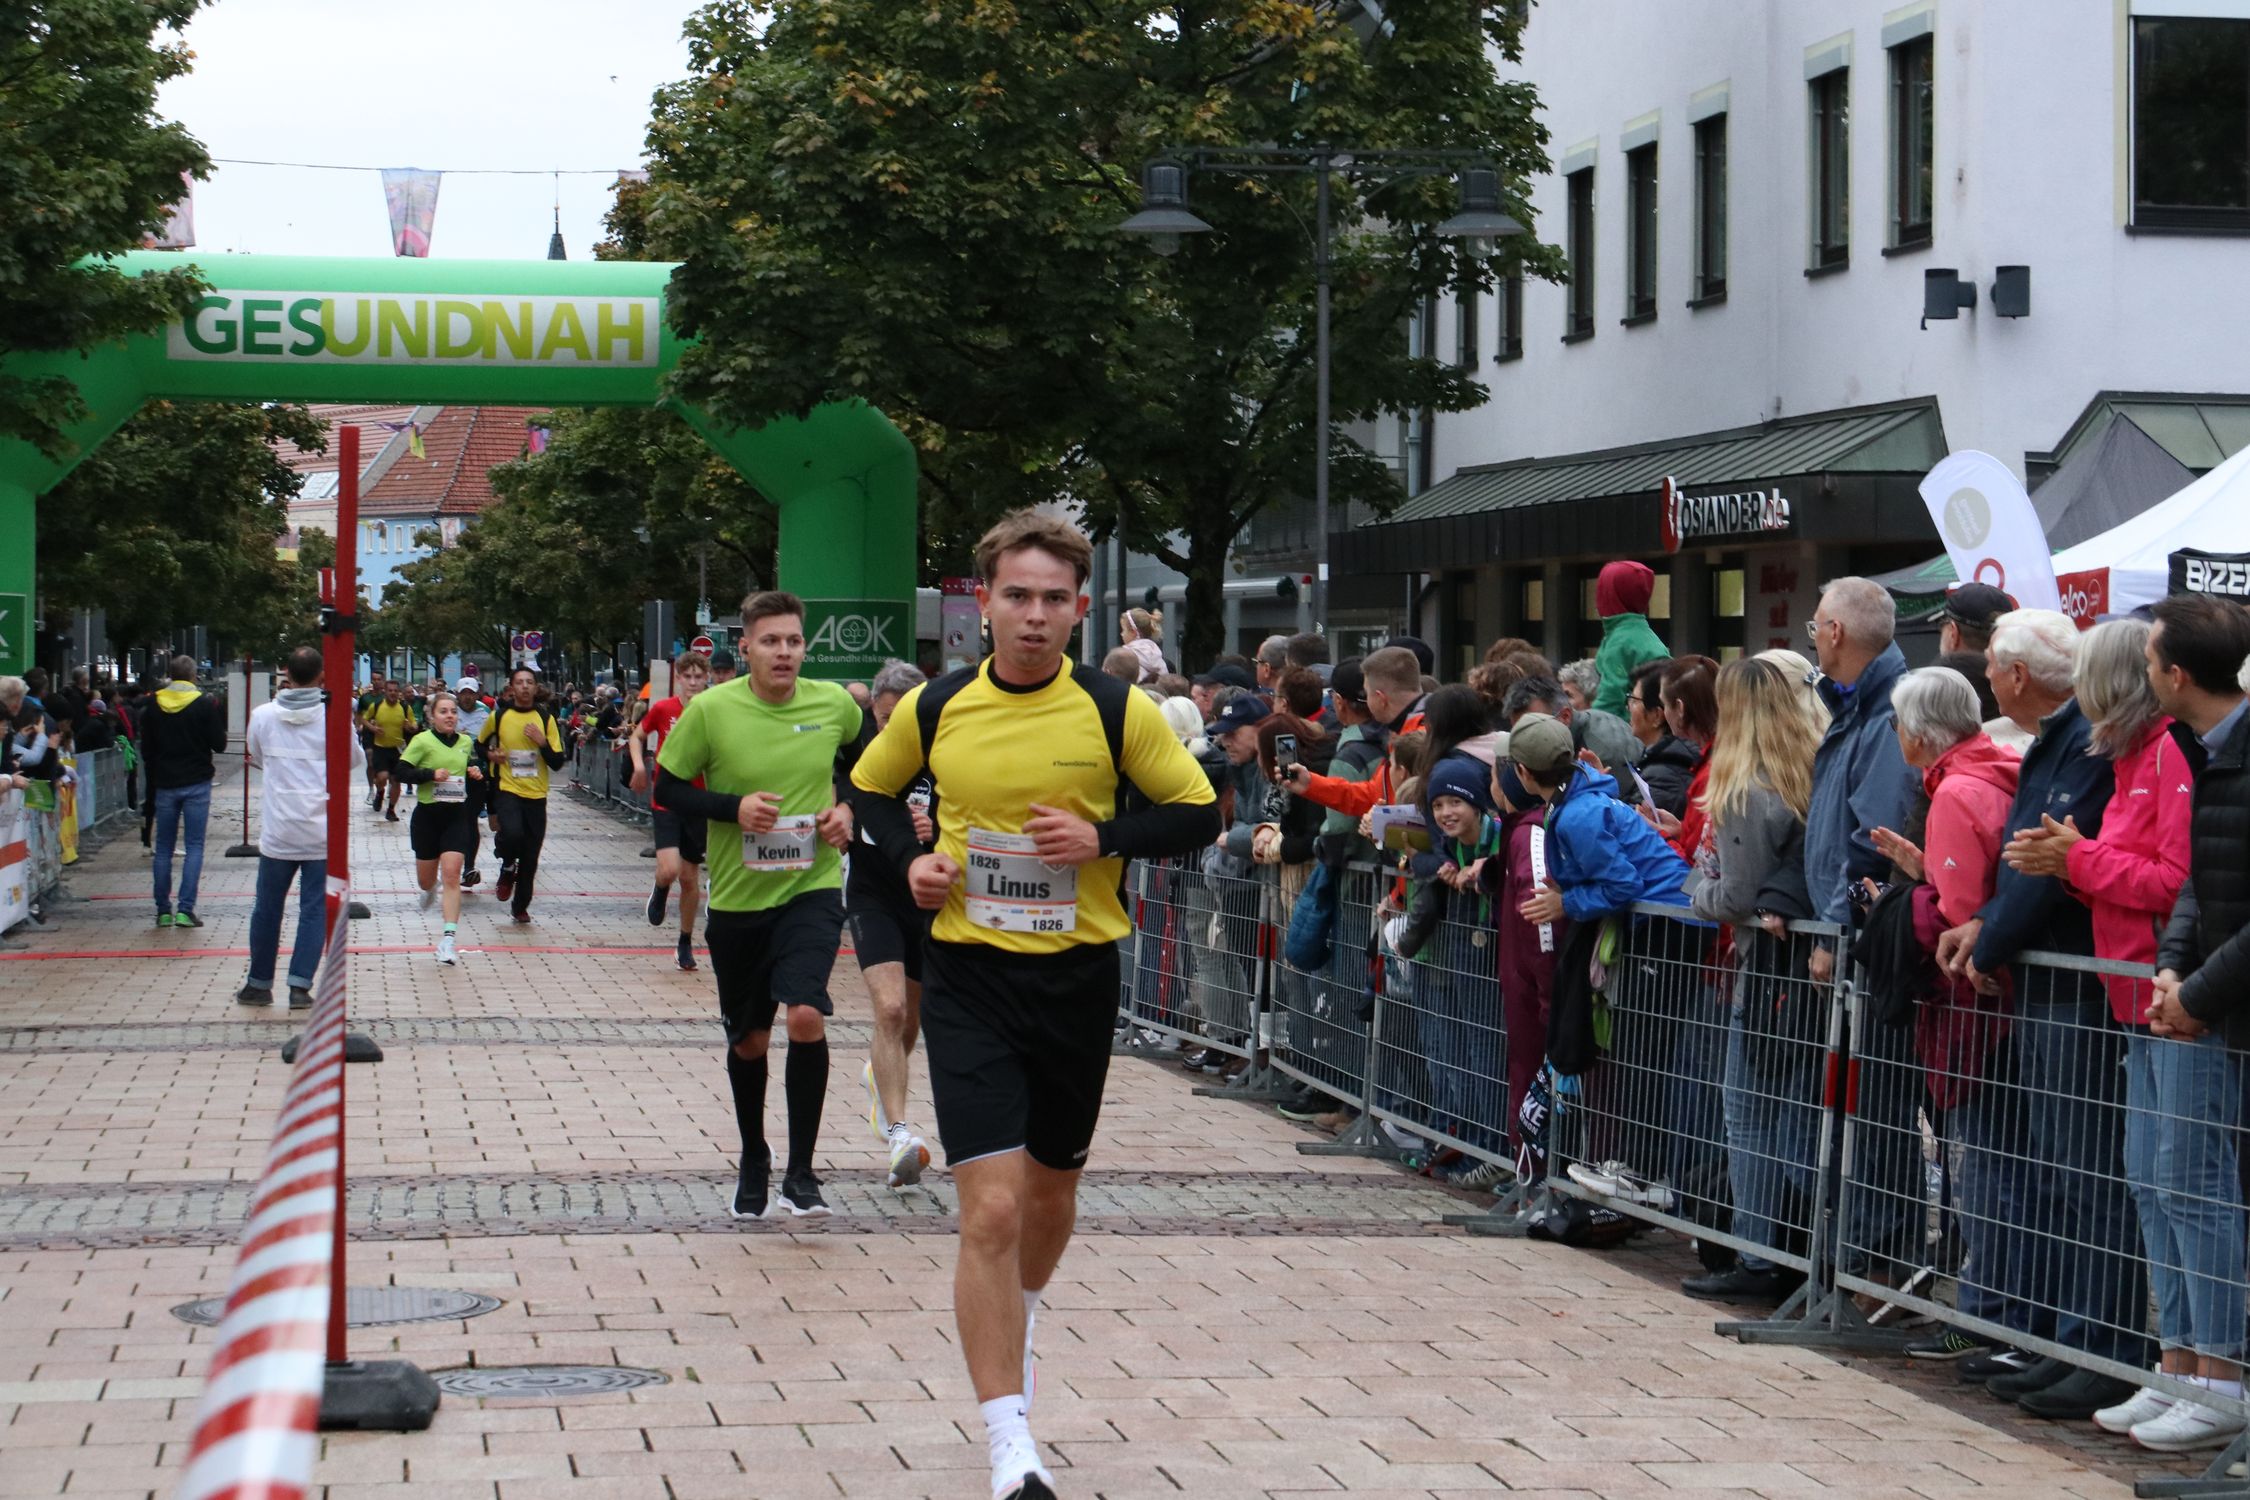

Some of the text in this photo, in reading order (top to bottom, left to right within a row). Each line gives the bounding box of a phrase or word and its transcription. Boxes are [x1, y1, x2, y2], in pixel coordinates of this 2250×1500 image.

[185, 296, 645, 362] GESUNDNAH
[806, 614, 895, 653] AOK
[757, 845, 801, 860] Kevin
[969, 854, 1001, 870] 1826
[987, 873, 1051, 899] Linus
[1031, 919, 1064, 931] 1826
